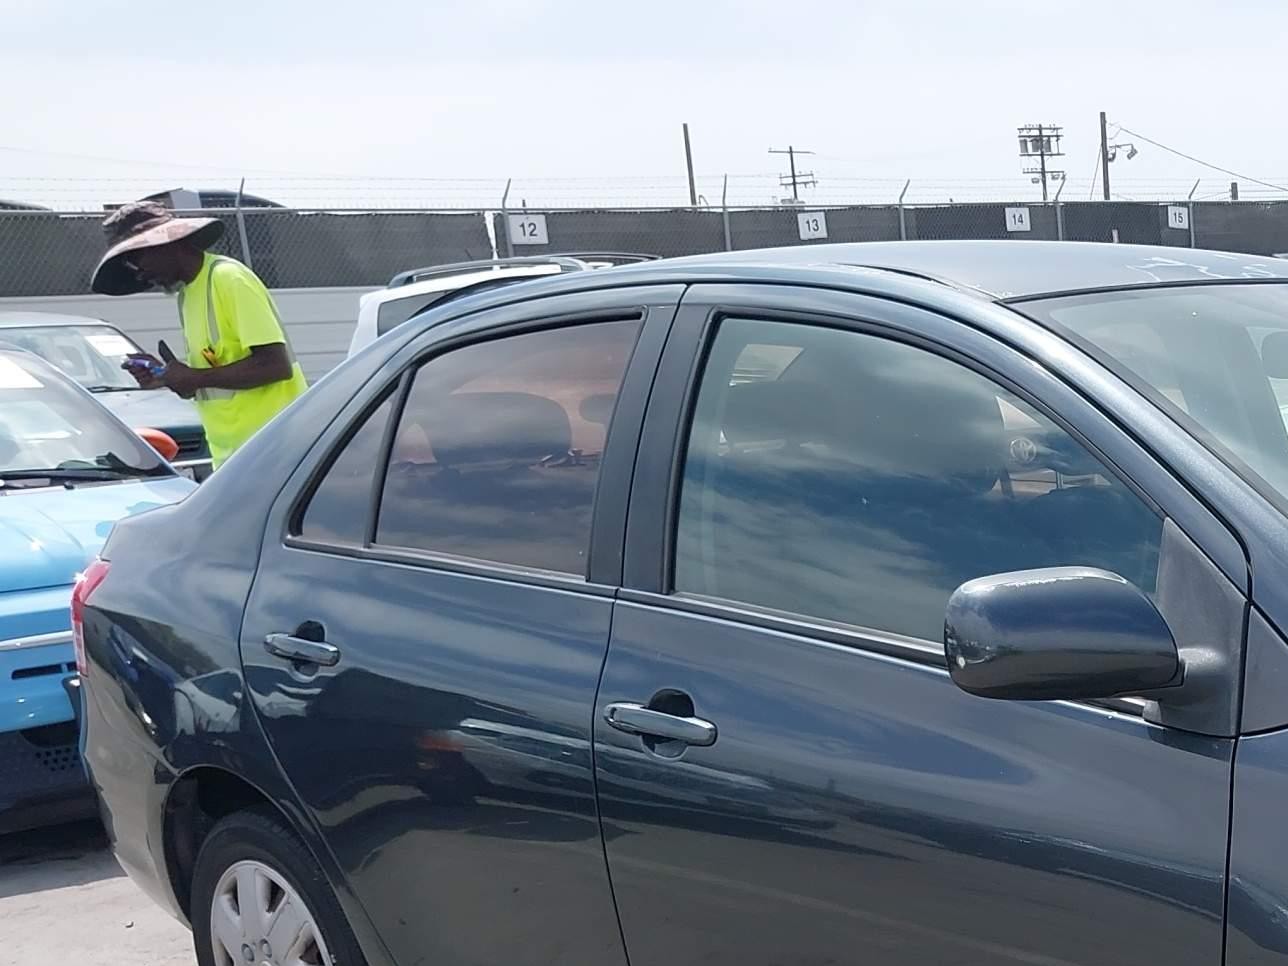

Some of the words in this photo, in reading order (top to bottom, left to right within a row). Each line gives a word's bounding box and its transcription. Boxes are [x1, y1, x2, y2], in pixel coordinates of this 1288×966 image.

[1012, 213, 1024, 225] 14
[1174, 211, 1183, 223] 15
[519, 221, 538, 237] 12
[806, 218, 820, 232] 13
